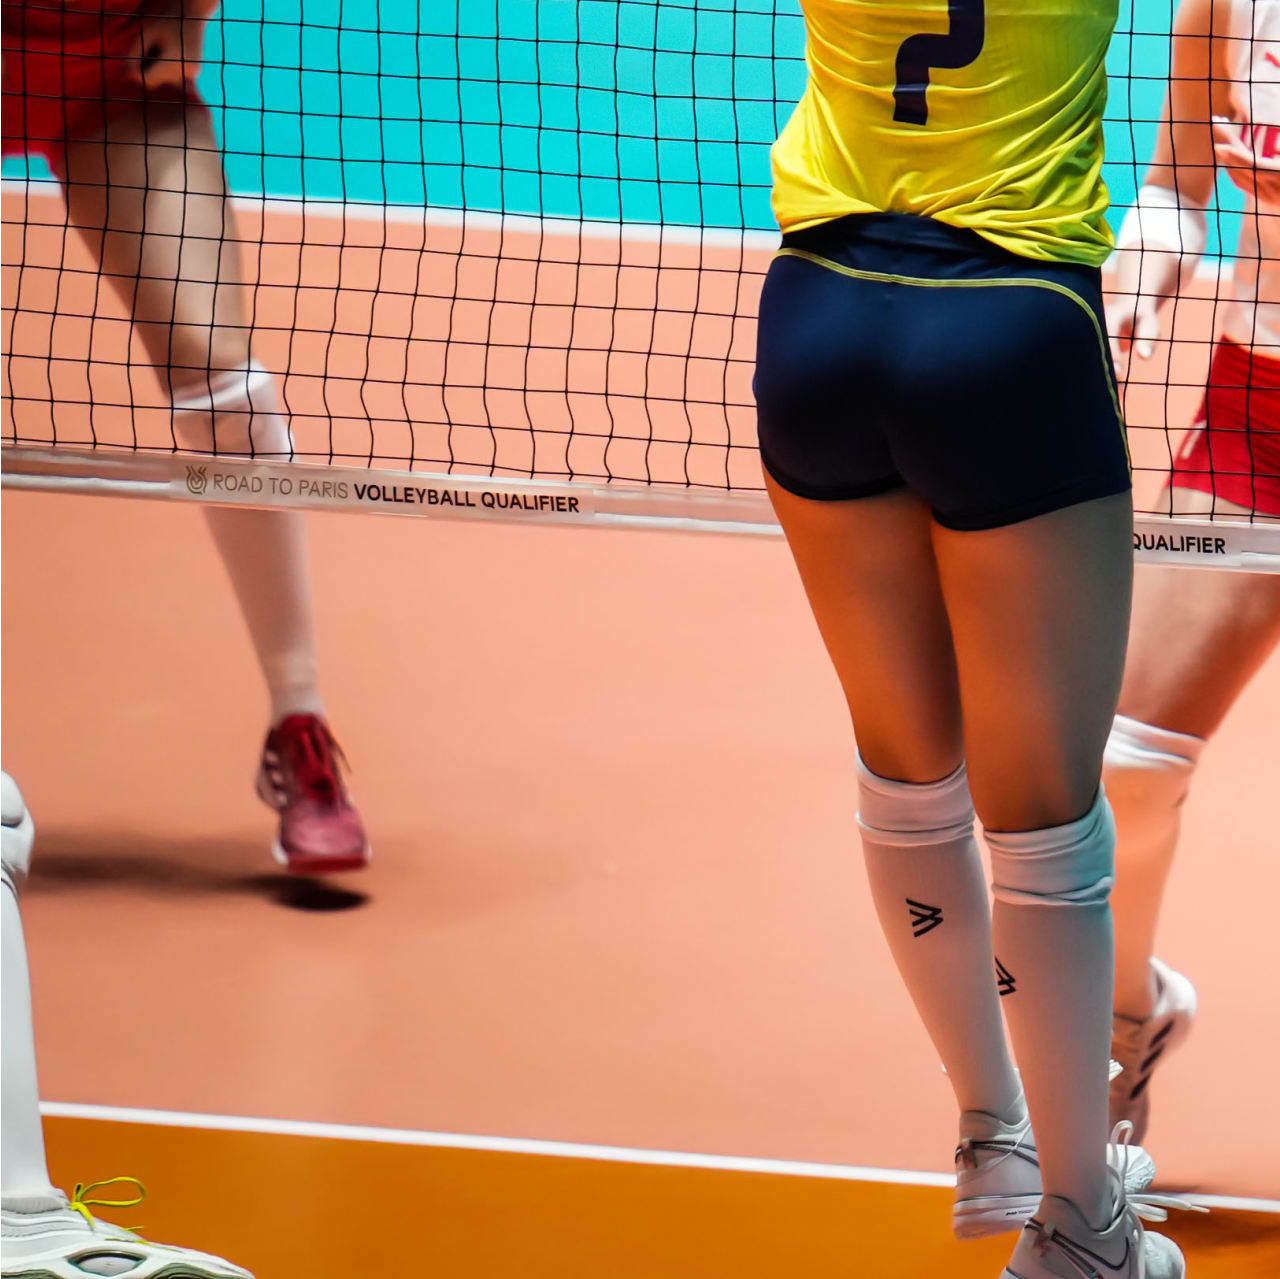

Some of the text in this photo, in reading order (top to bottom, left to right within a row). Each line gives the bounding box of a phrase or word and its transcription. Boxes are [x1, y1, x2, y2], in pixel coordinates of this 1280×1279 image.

[213, 473, 580, 513] ROAD TO PARIS VOLLEYBALL QUALIFIER
